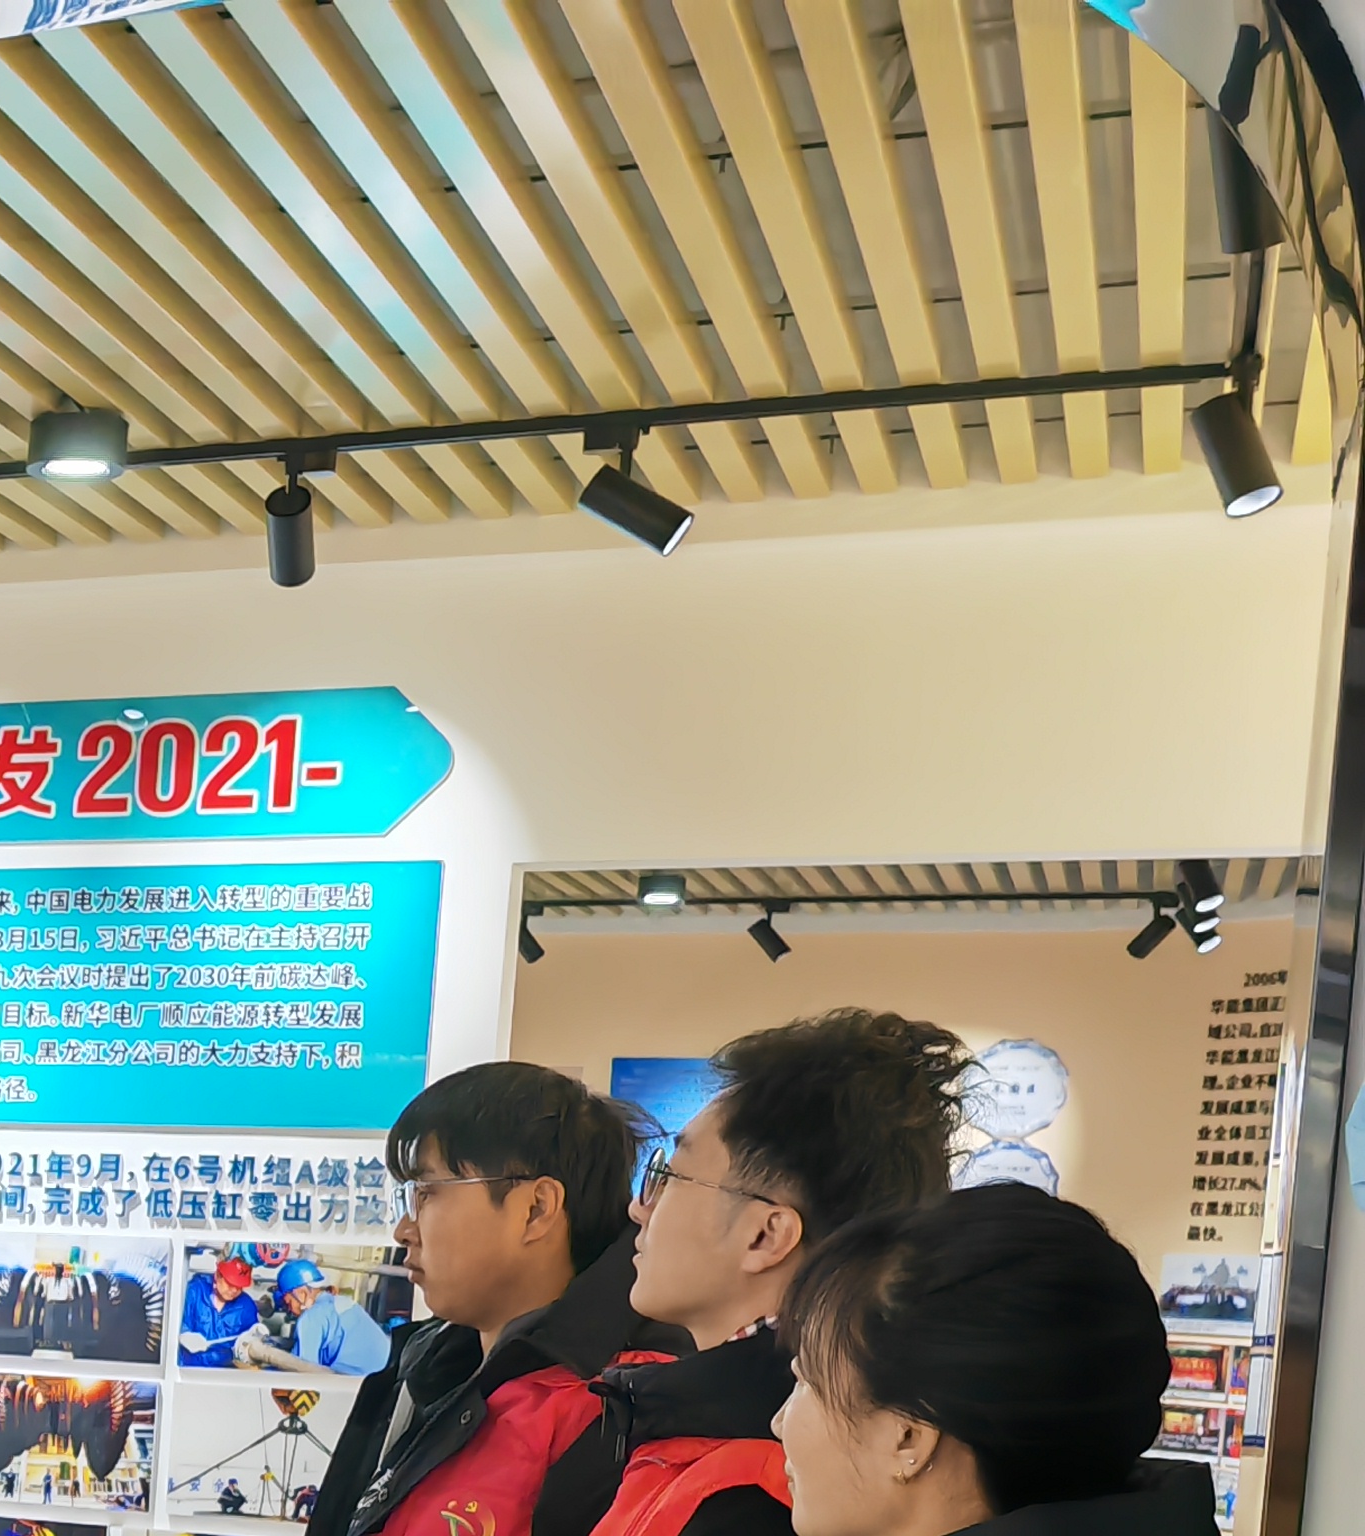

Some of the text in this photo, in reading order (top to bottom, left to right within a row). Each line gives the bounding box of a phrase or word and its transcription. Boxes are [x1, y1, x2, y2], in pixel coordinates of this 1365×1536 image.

[1190, 1200, 1265, 1217] 在黑龙江公
